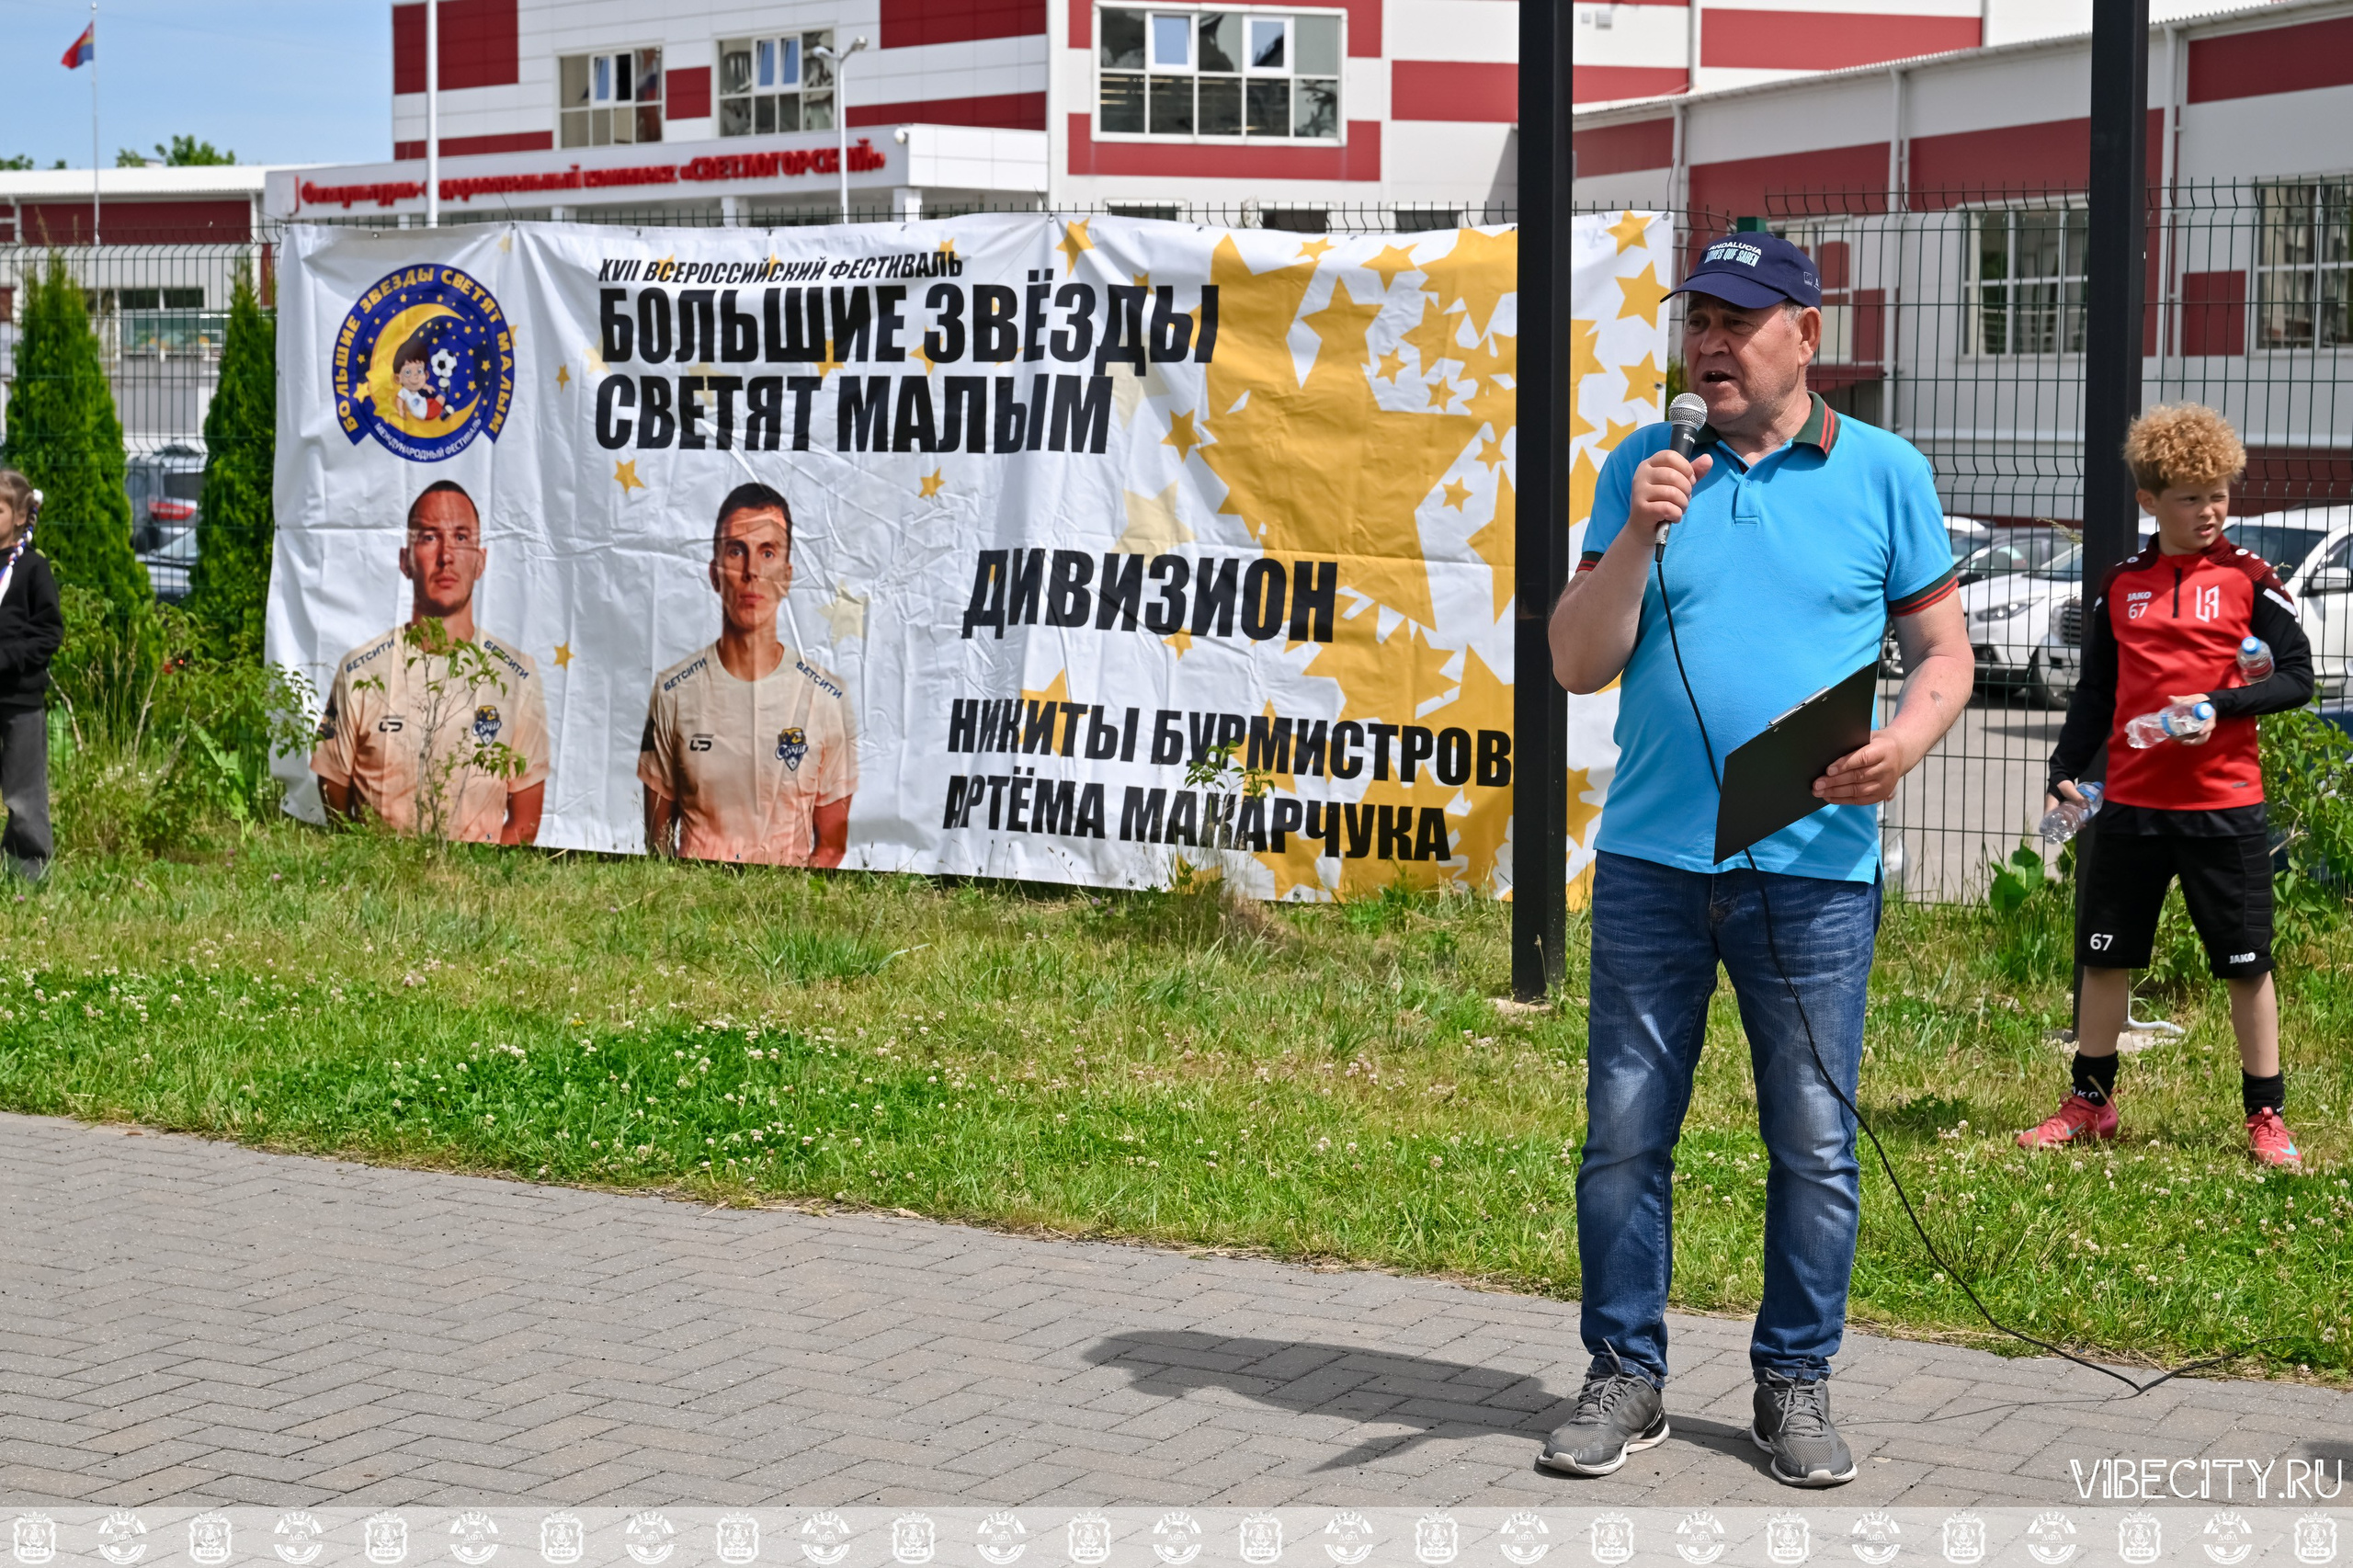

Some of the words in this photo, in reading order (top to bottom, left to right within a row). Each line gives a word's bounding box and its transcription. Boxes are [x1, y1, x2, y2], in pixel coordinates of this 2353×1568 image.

[597, 258, 642, 282] XVII
[643, 256, 827, 284] ВСЕРОССИЙСКИЙ
[829, 252, 962, 281] ФЕСТИВАЛЬ
[599, 286, 906, 362] БОЛЬШИЕ
[924, 267, 1220, 376] ЗВЁЗДЫ
[335, 315, 361, 433] БОЛЬШИЕ
[359, 267, 434, 313] ЗВЕЗДЫ
[441, 269, 502, 323] СВЕТЯТ
[488, 331, 513, 434] МАЛЫМ
[595, 374, 822, 451] СВЕТЯТ
[837, 375, 1113, 454] МАЛЫМ
[445, 417, 483, 456] ФЕСТИВАЛЬ
[961, 549, 1338, 642] ДИВИЗИОН
[2126, 590, 2152, 602] JAKO
[2128, 602, 2149, 619] 67
[346, 637, 395, 674] БЕТСИТИ
[664, 657, 708, 691] БЕТСИТИ
[796, 661, 843, 699] БЕТСИТИ
[948, 699, 1139, 763] НИКИТЫ
[942, 767, 1106, 840] АРТЁМА
[1119, 786, 1452, 862] МАКАРЧУКА
[2089, 933, 2114, 952] 67
[2229, 952, 2256, 964] JAKO
